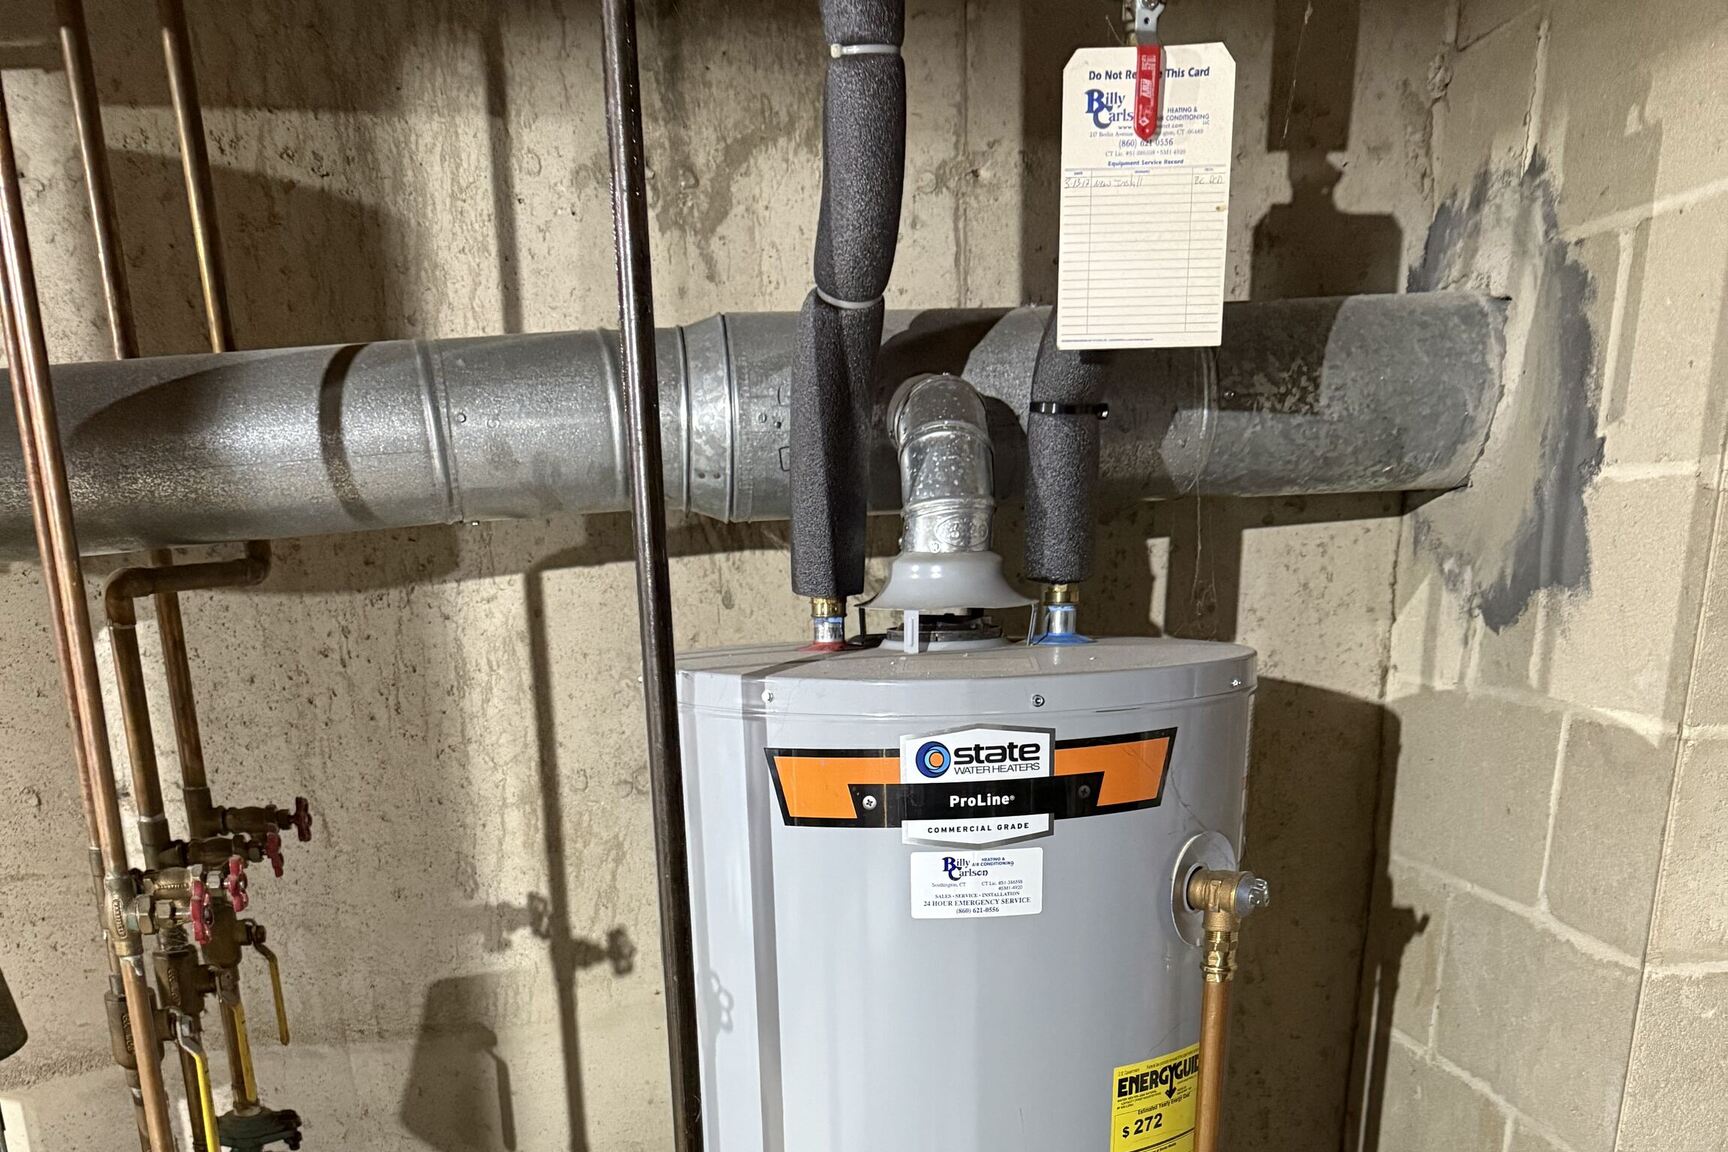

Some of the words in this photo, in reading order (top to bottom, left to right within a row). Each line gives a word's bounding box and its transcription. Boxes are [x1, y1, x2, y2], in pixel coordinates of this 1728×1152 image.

[1089, 71, 1101, 80] Do
[1105, 70, 1122, 79] Not
[1166, 69, 1184, 78] This
[1188, 67, 1210, 77] Card
[1084, 89, 1125, 114] Billy
[1093, 109, 1134, 129] Carls
[1119, 140, 1137, 148] (860)
[954, 742, 1040, 765] state
[954, 765, 991, 775] WATER
[992, 763, 1040, 773] HEATERS
[928, 825, 992, 833] COMMERCIAL
[942, 856, 970, 872] Billy
[948, 869, 988, 881] Carlson
[1122, 1126, 1129, 1138] $
[1134, 1113, 1162, 1135] 272
